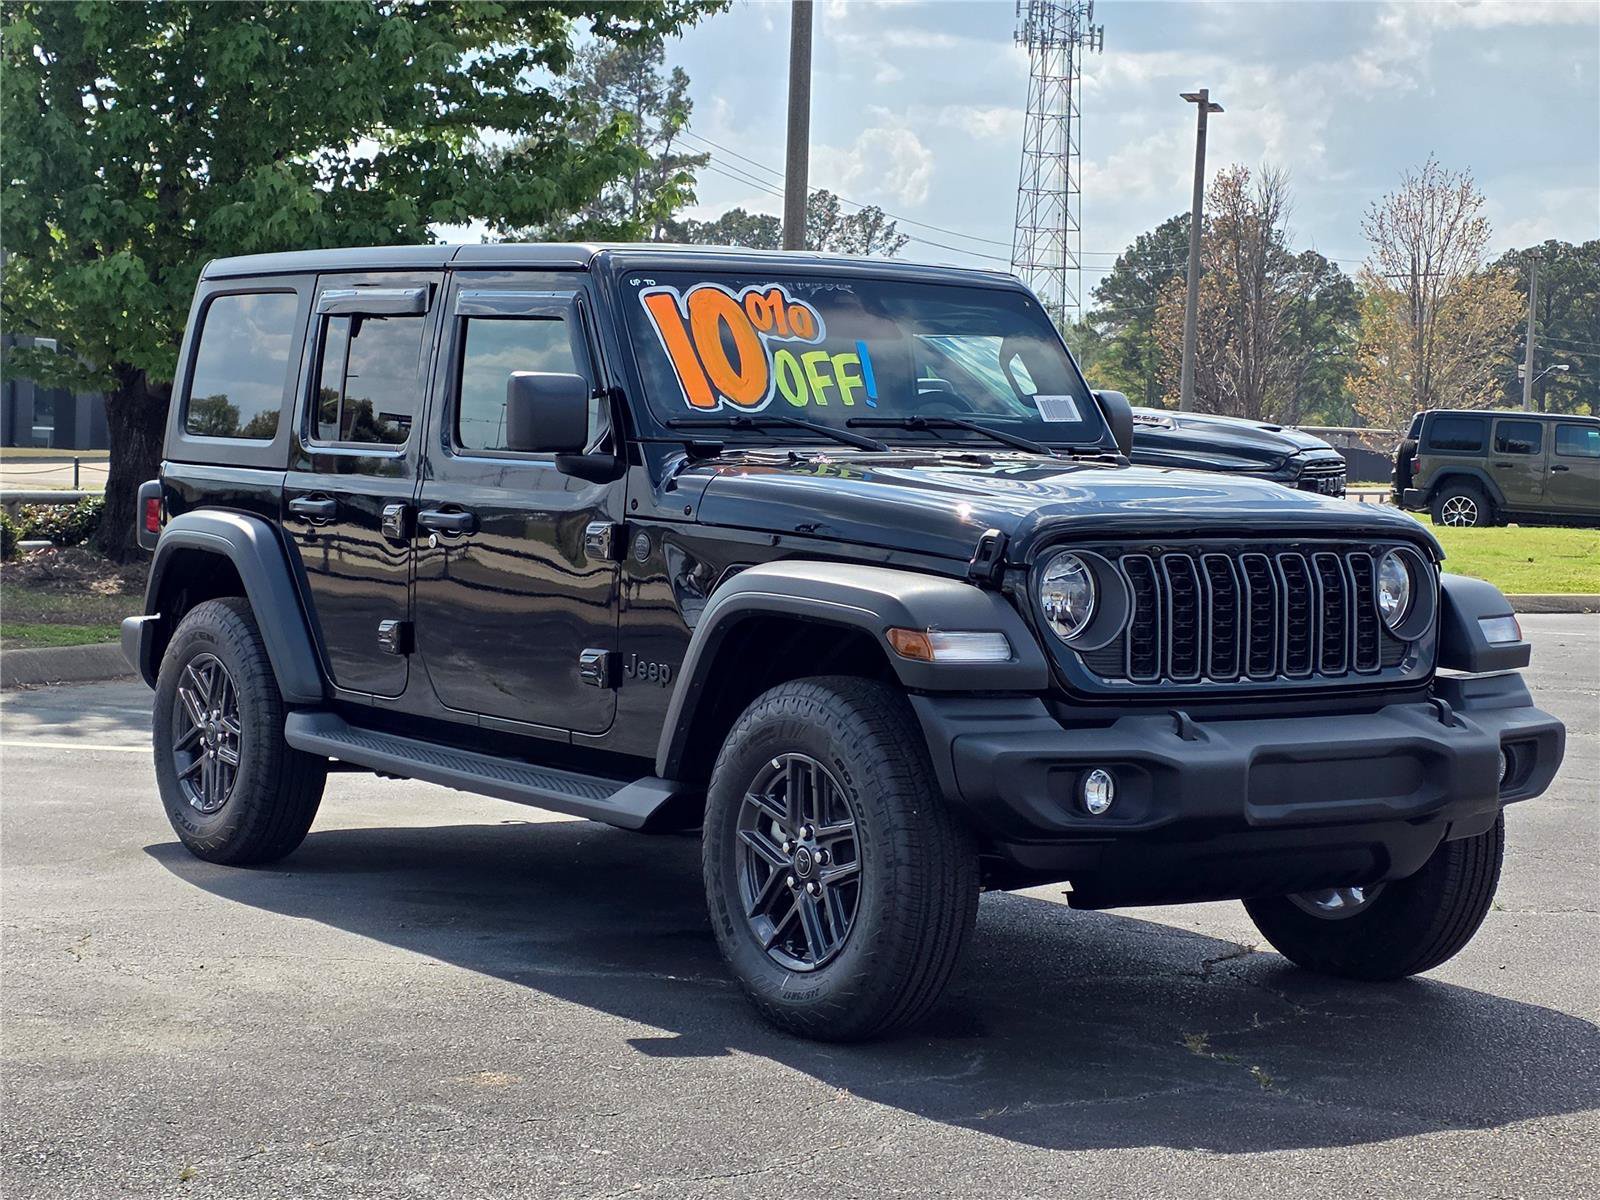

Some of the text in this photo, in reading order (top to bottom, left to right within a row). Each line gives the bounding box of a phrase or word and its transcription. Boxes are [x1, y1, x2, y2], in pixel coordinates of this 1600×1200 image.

[630, 278, 656, 287] UP TO
[774, 340, 879, 409] OFF!
[624, 653, 672, 688] Jeep
